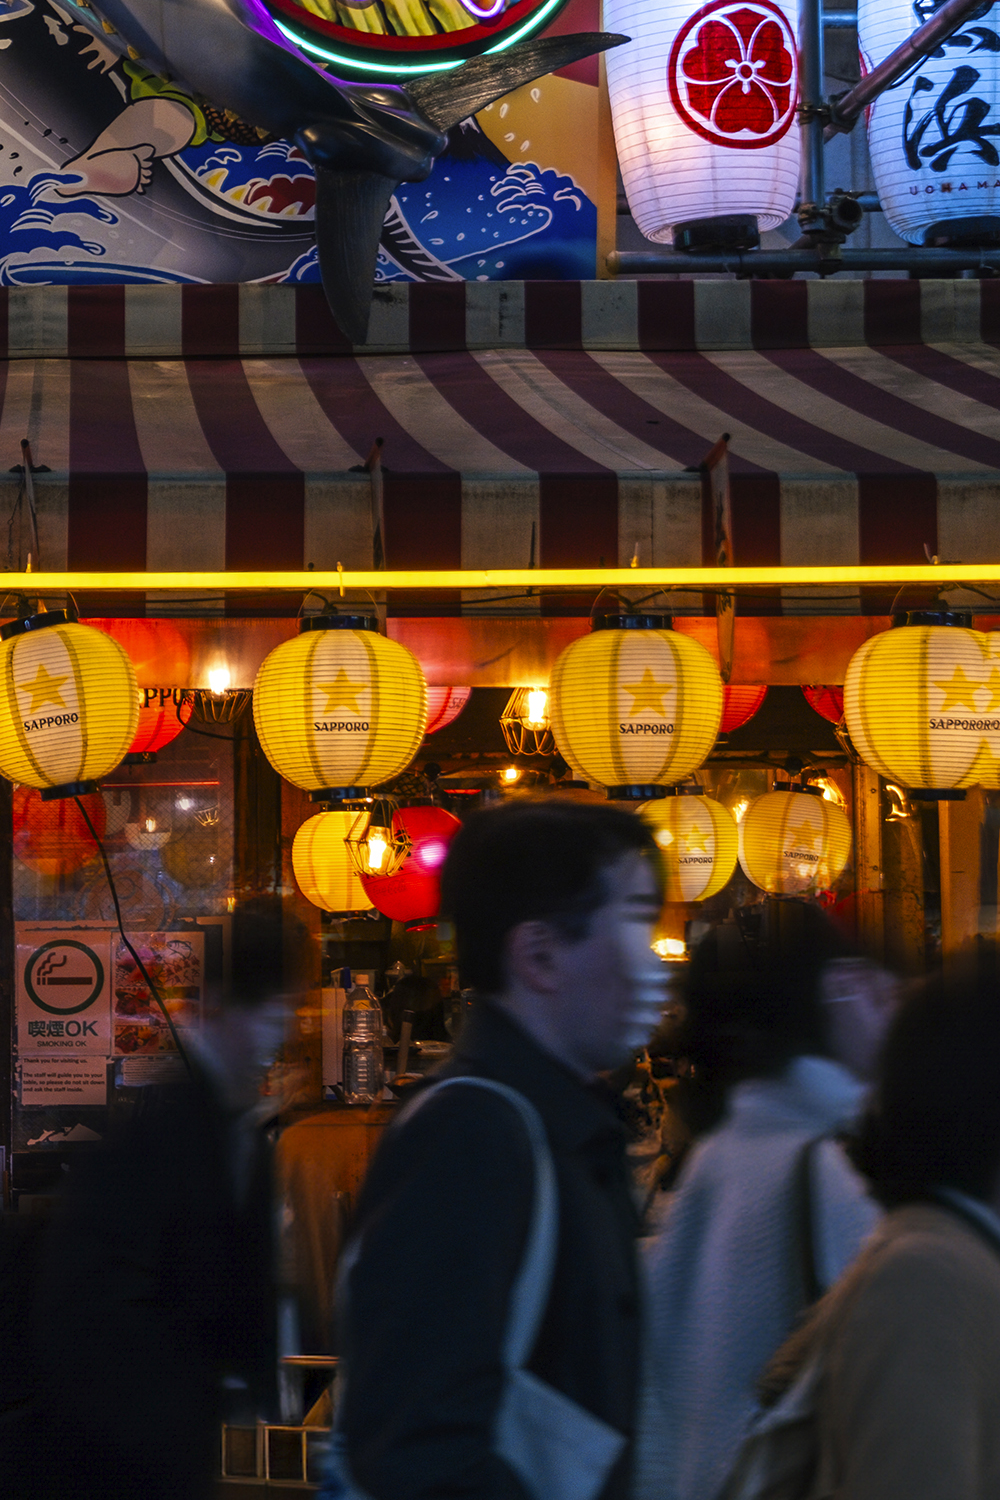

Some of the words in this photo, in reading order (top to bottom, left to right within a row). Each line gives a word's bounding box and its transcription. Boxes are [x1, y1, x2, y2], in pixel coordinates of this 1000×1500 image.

[23, 711, 80, 732] SAPPORO
[313, 720, 370, 733] SAPPORO
[618, 722, 675, 736] SAPPORO
[678, 856, 713, 865] SAPPORO
[783, 850, 819, 862] SAPPORO
[28, 1020, 98, 1038] 喫煙OK
[37, 1040, 73, 1048] SMOKING
[75, 1040, 87, 1048] OK
